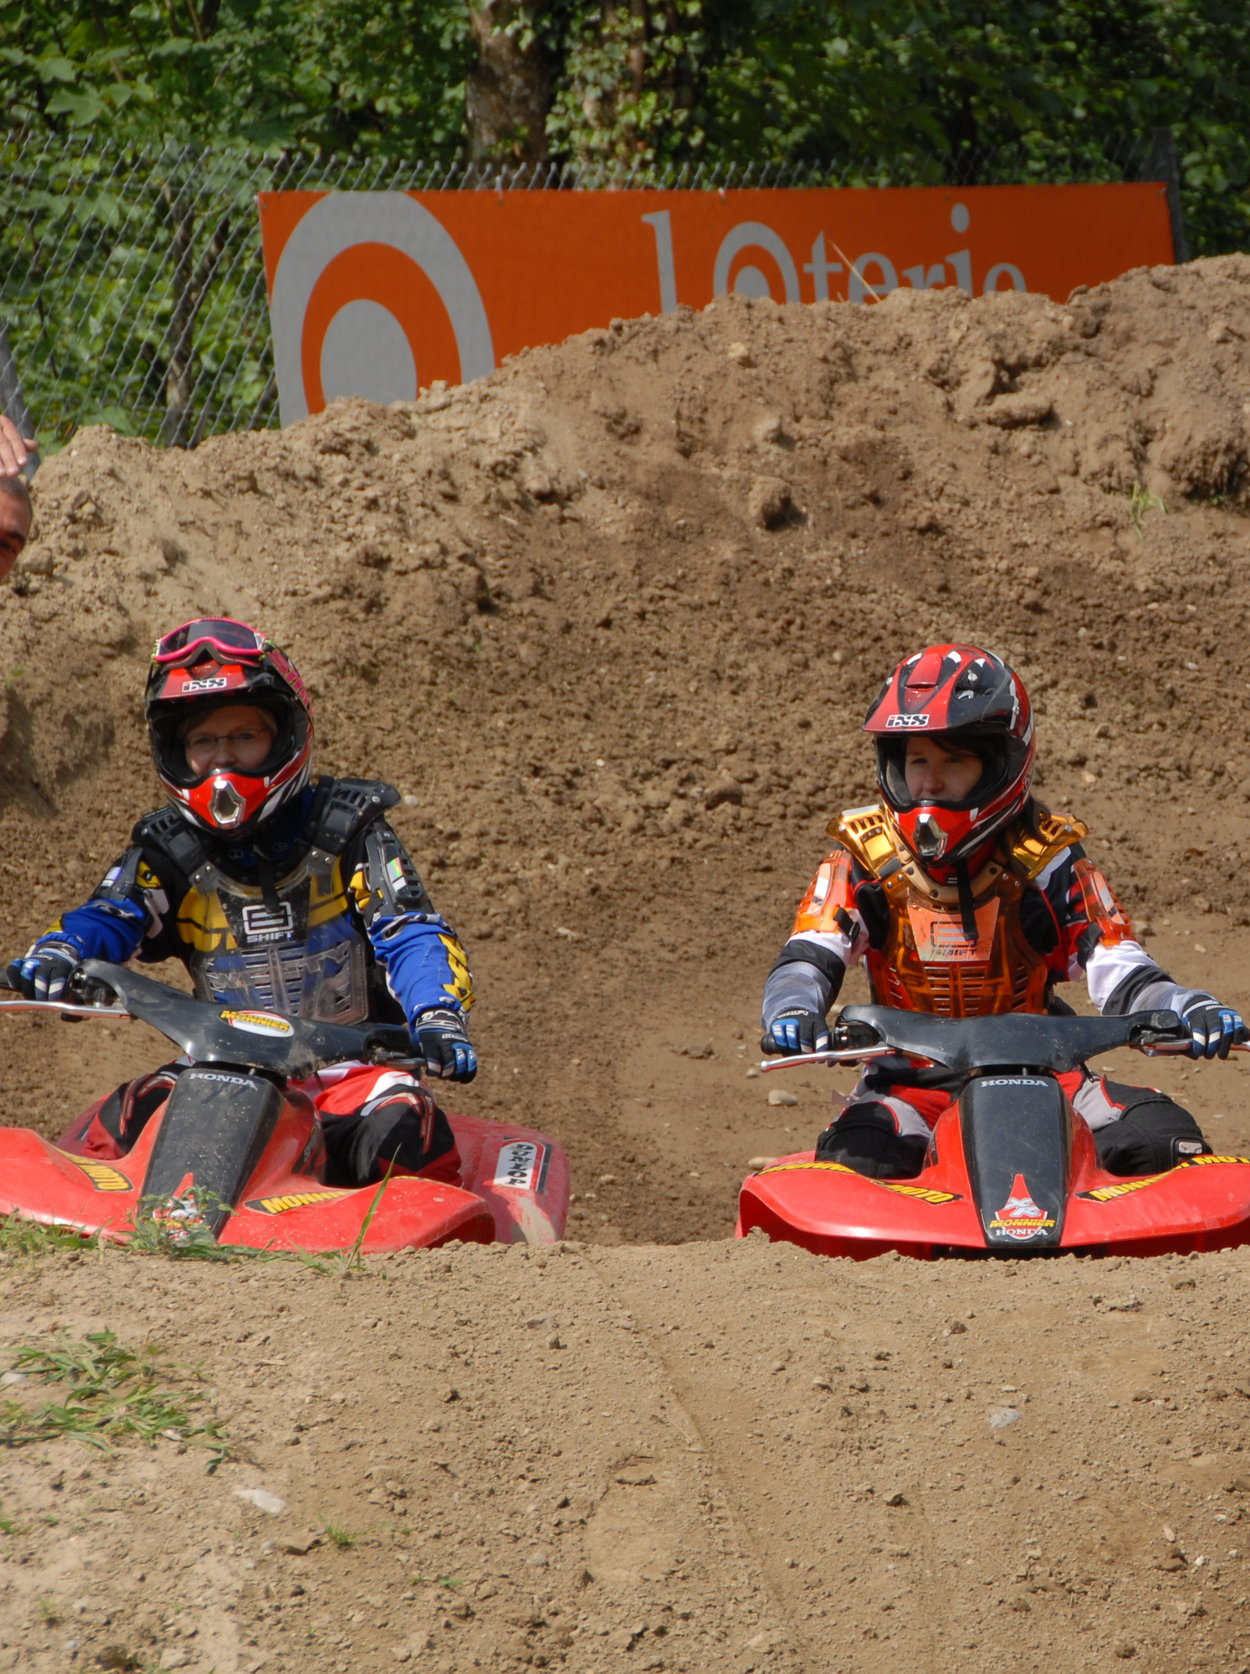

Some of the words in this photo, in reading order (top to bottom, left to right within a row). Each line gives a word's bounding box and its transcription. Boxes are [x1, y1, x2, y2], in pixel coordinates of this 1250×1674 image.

[247, 931, 294, 943] SHIFT
[220, 1010, 290, 1032] MONNIER
[188, 1073, 258, 1091] HONDA
[981, 1079, 1048, 1087] HONDA
[989, 1219, 1055, 1229] MONNIER
[996, 1228, 1048, 1237] HONDA
